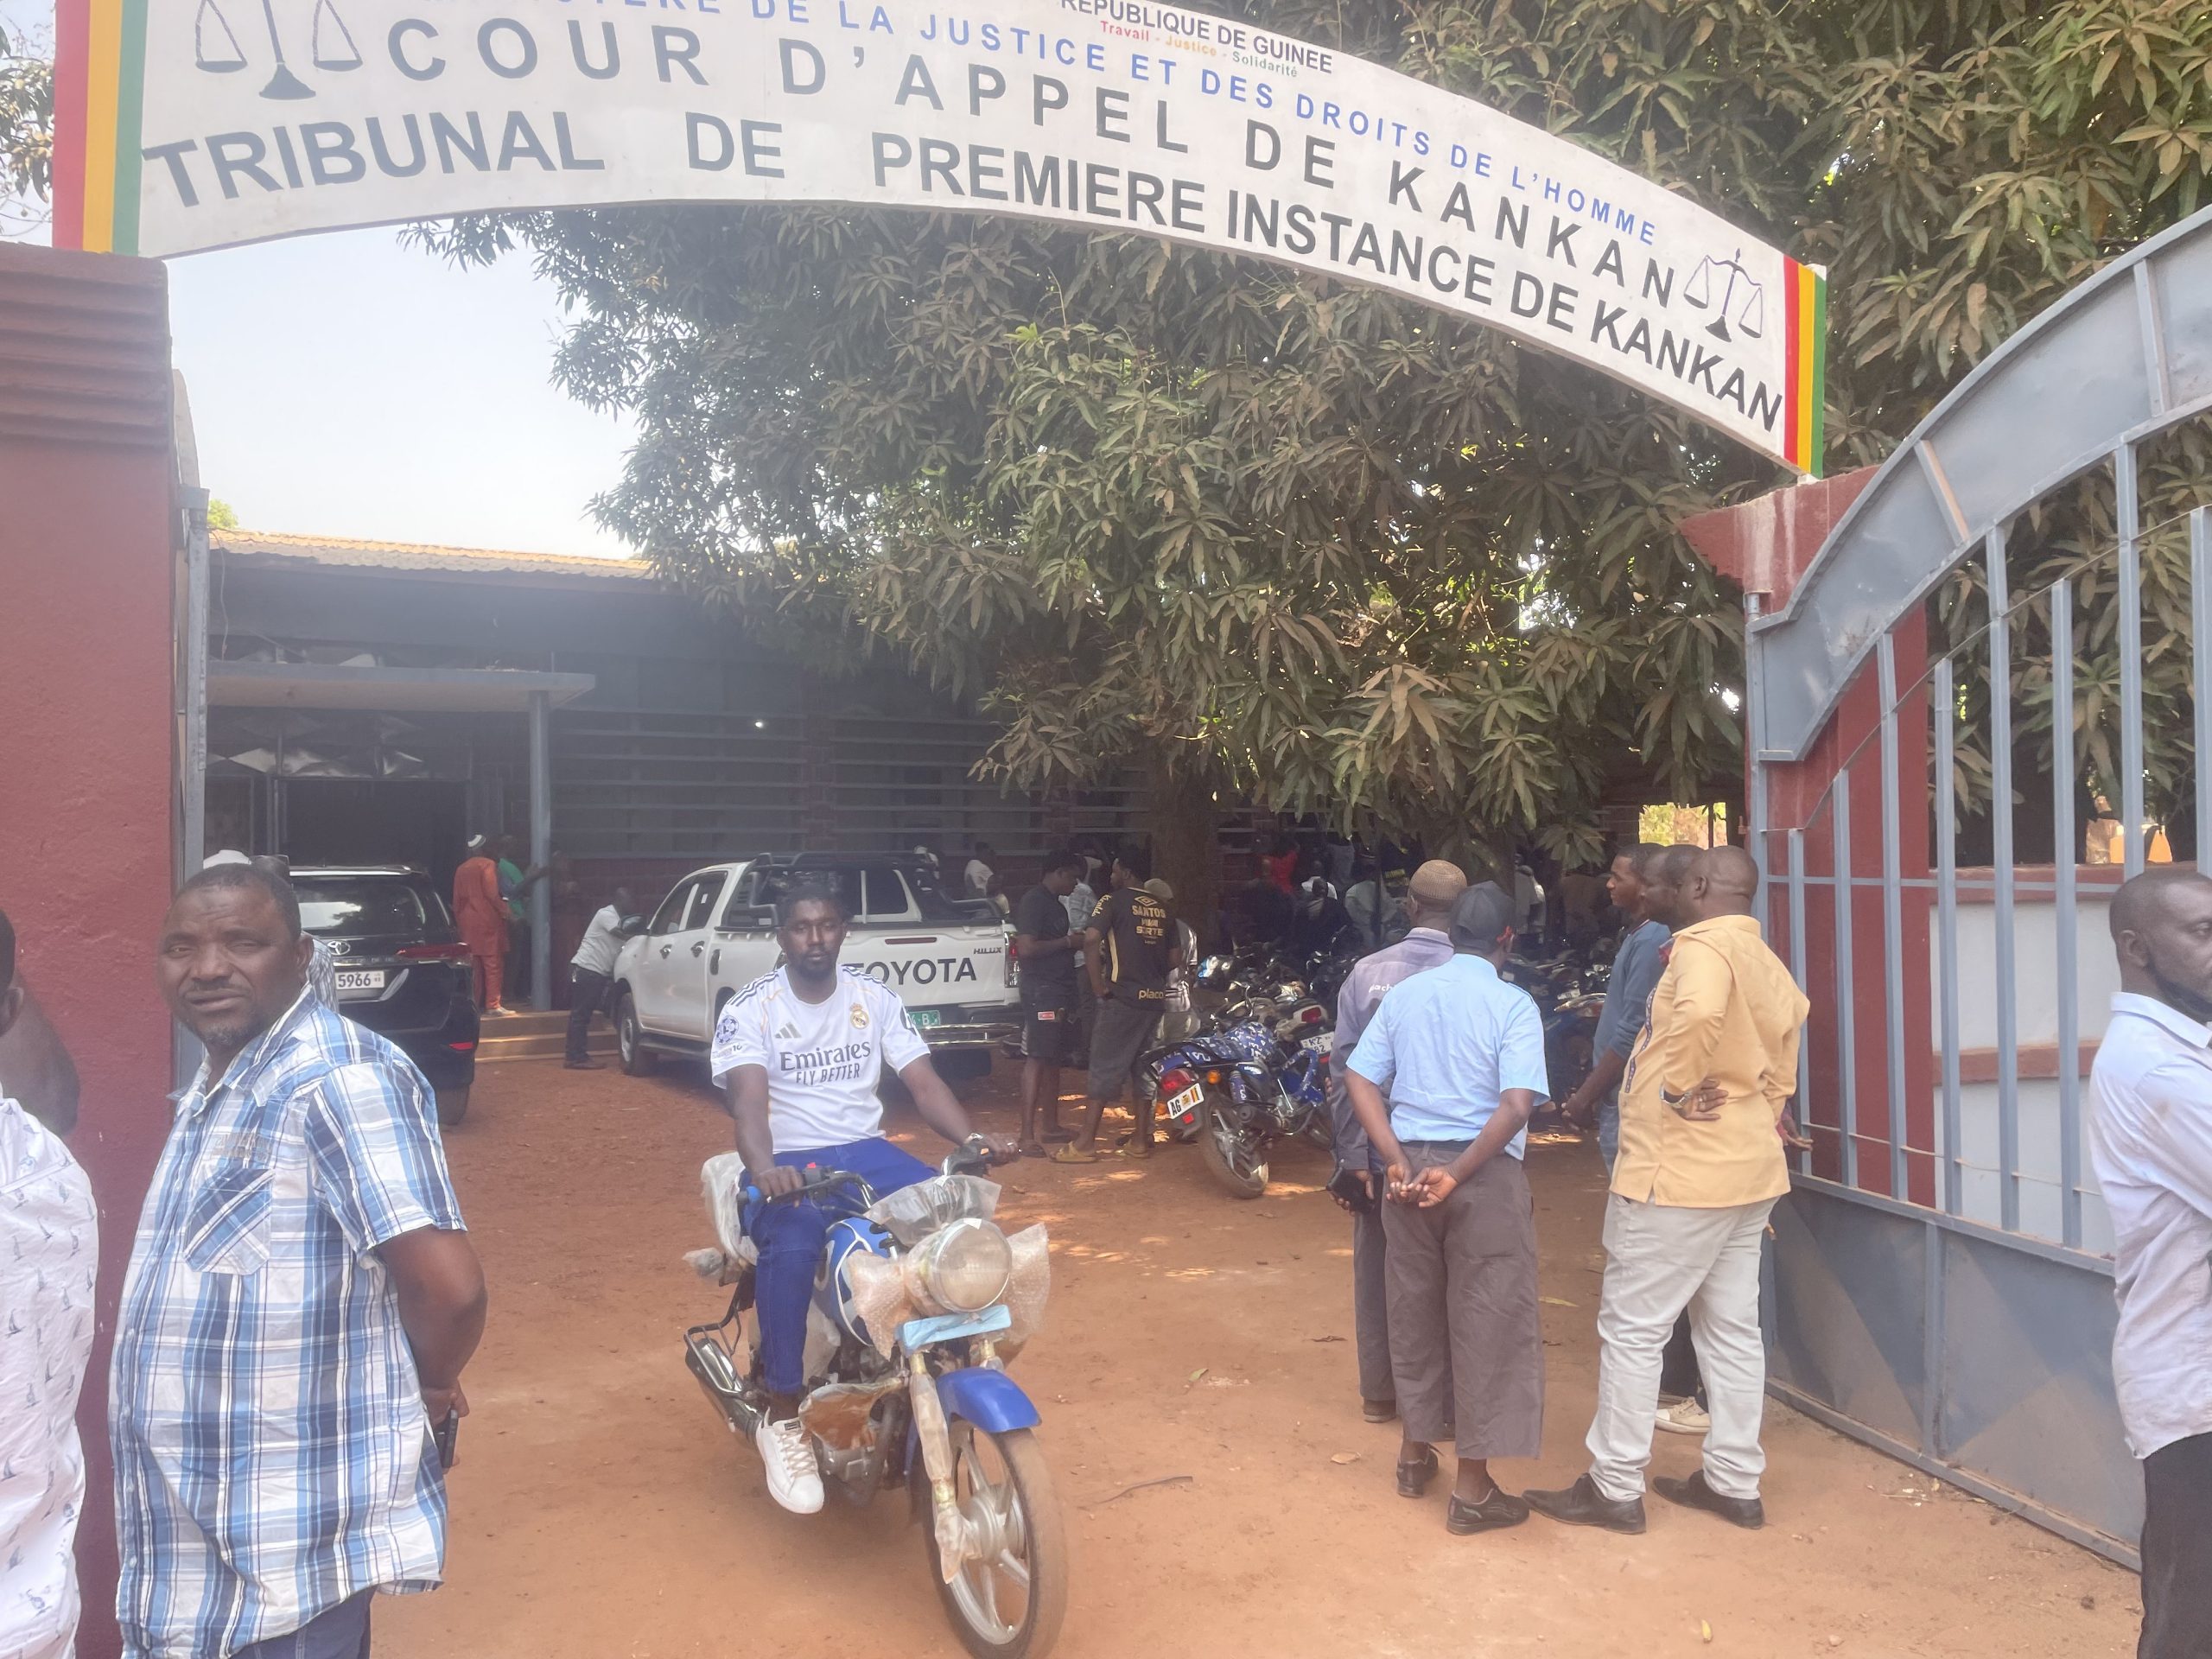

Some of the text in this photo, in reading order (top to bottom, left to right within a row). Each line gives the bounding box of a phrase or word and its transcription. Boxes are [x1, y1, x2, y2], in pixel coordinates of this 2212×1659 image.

[1100, 20, 1150, 42] Travail
[1165, 35, 1217, 57] Justice
[1232, 51, 1299, 78] Solidarité
[1217, 24, 1246, 50] DE
[1253, 35, 1333, 74] GUINEE
[752, 0, 1656, 246] DE LA JUSTICE ET DES DROITS DE L'HOMME
[387, 17, 1675, 308] COUR D'APPEL DE KANKAN
[141, 111, 1783, 433] TRIBUNAL DE PREMIERE INSTANCE DE KANKAN
[1132, 905, 1166, 918] SANTOS
[338, 973, 372, 988] 5966
[779, 1041, 871, 1071] Emirates
[796, 1063, 861, 1085] FLY BETTER
[1170, 1099, 1182, 1116] AG
